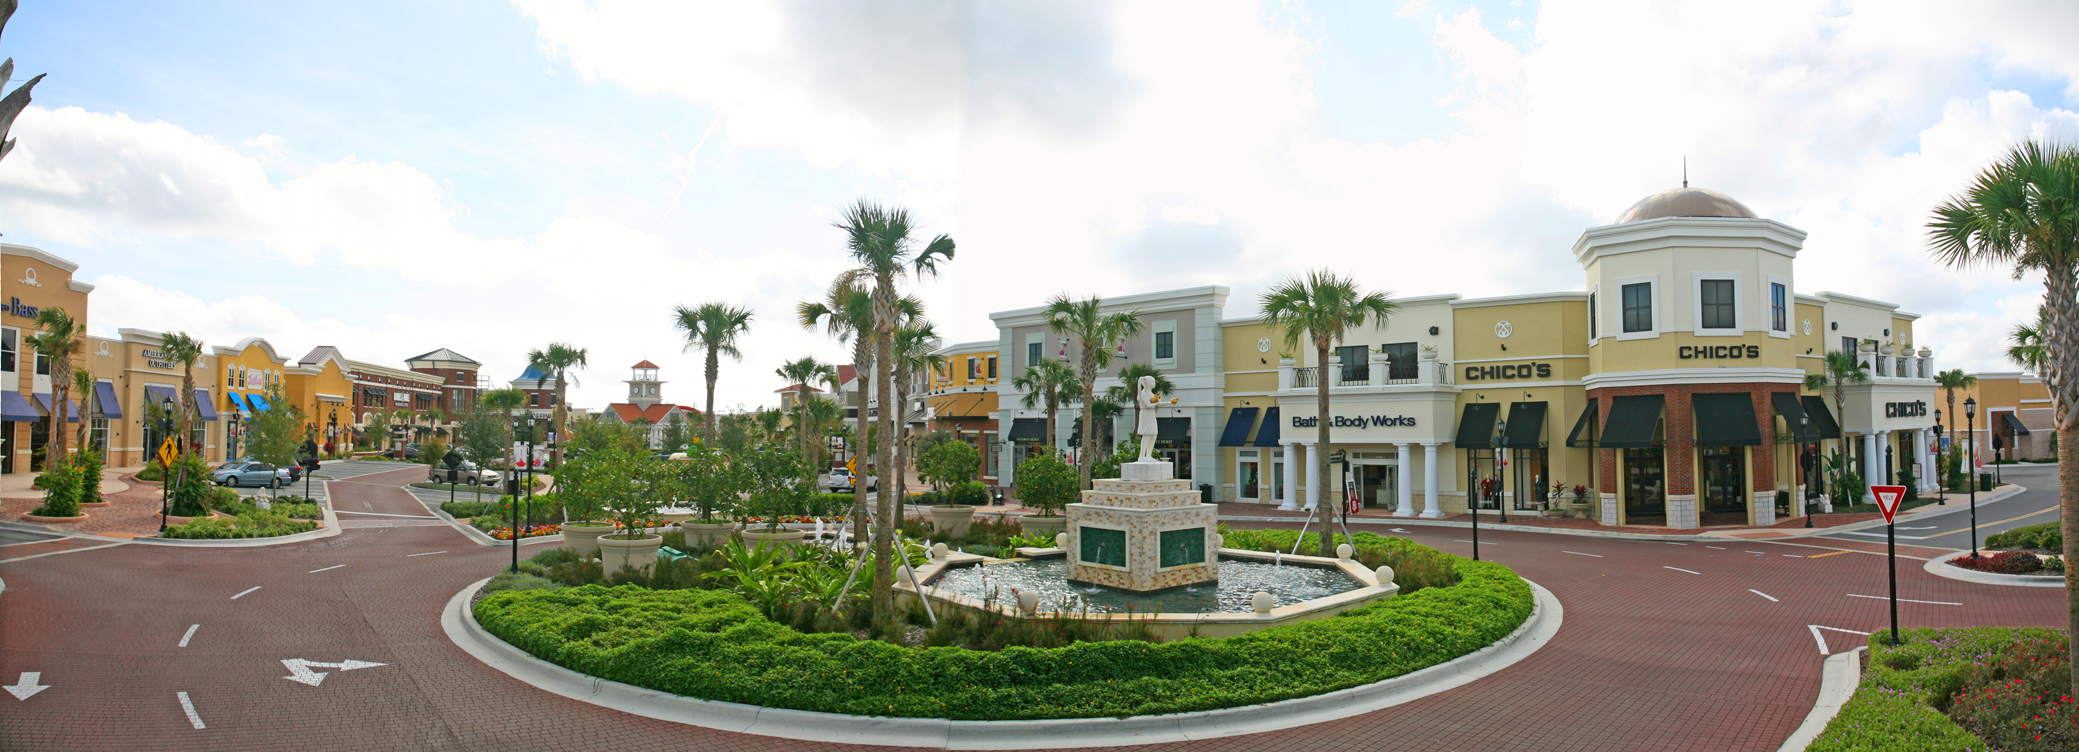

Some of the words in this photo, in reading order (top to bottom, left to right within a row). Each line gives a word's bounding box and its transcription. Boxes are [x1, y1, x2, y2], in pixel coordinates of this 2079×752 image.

[11, 296, 39, 318] Bass
[1679, 344, 1759, 359] CHICO'S
[1465, 362, 1551, 380] CHICO'S
[1885, 400, 1927, 418] CHICO'S
[1335, 415, 1369, 429] Body
[1371, 415, 1416, 427] Works
